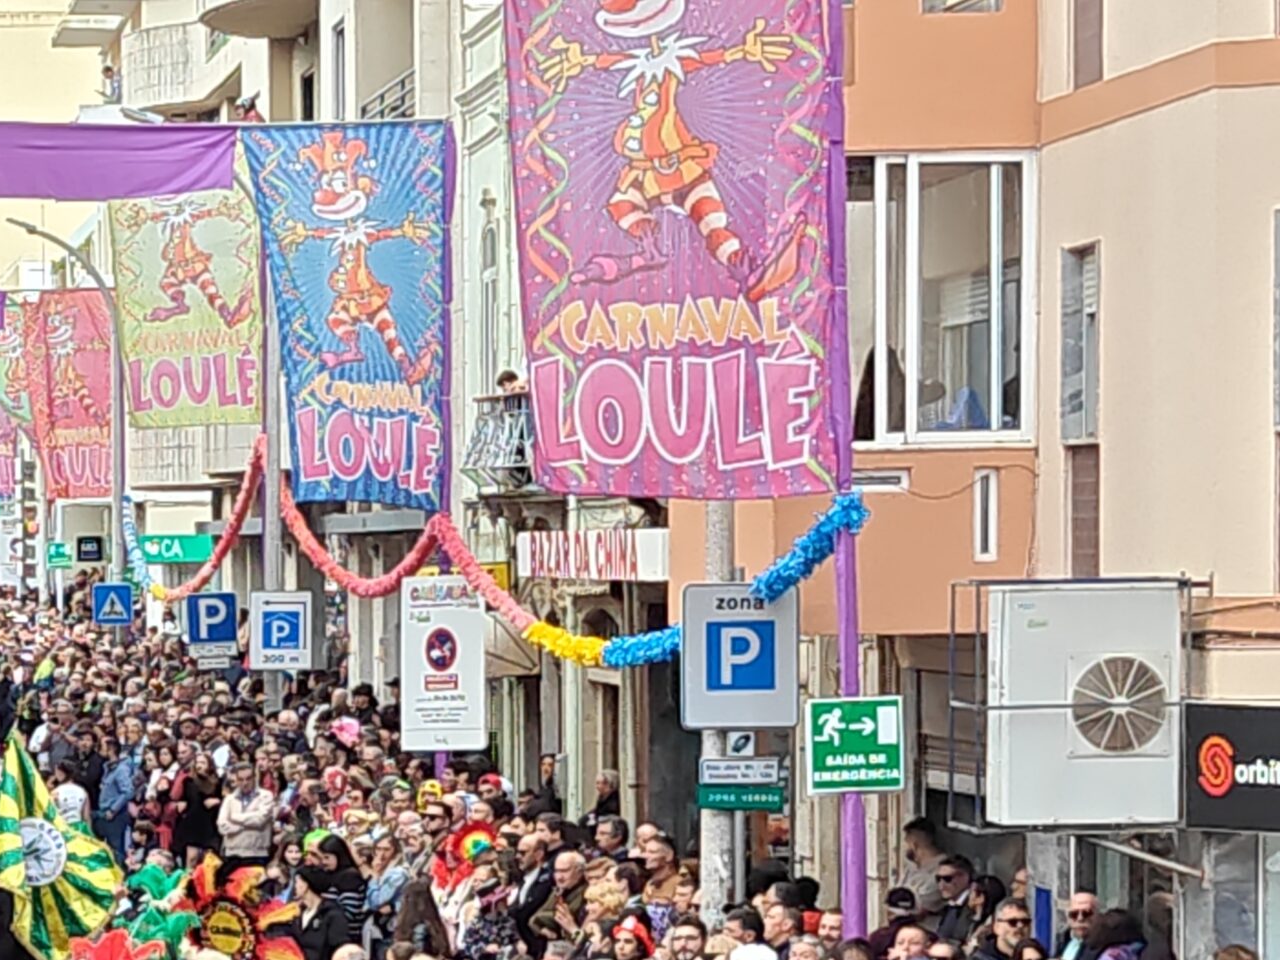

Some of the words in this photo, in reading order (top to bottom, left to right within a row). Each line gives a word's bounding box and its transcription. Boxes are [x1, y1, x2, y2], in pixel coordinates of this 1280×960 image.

[558, 299, 792, 355] CARNAVAL
[128, 343, 258, 413] LOULÉ
[530, 325, 820, 471] LOULÉ
[161, 538, 183, 559] CA
[530, 529, 570, 578] BAZAR
[595, 529, 638, 581] CHINA
[197, 598, 228, 639] P
[715, 597, 766, 611] zona
[721, 626, 761, 685] P
[825, 752, 867, 767] SAÍDA
[868, 753, 887, 764] DE
